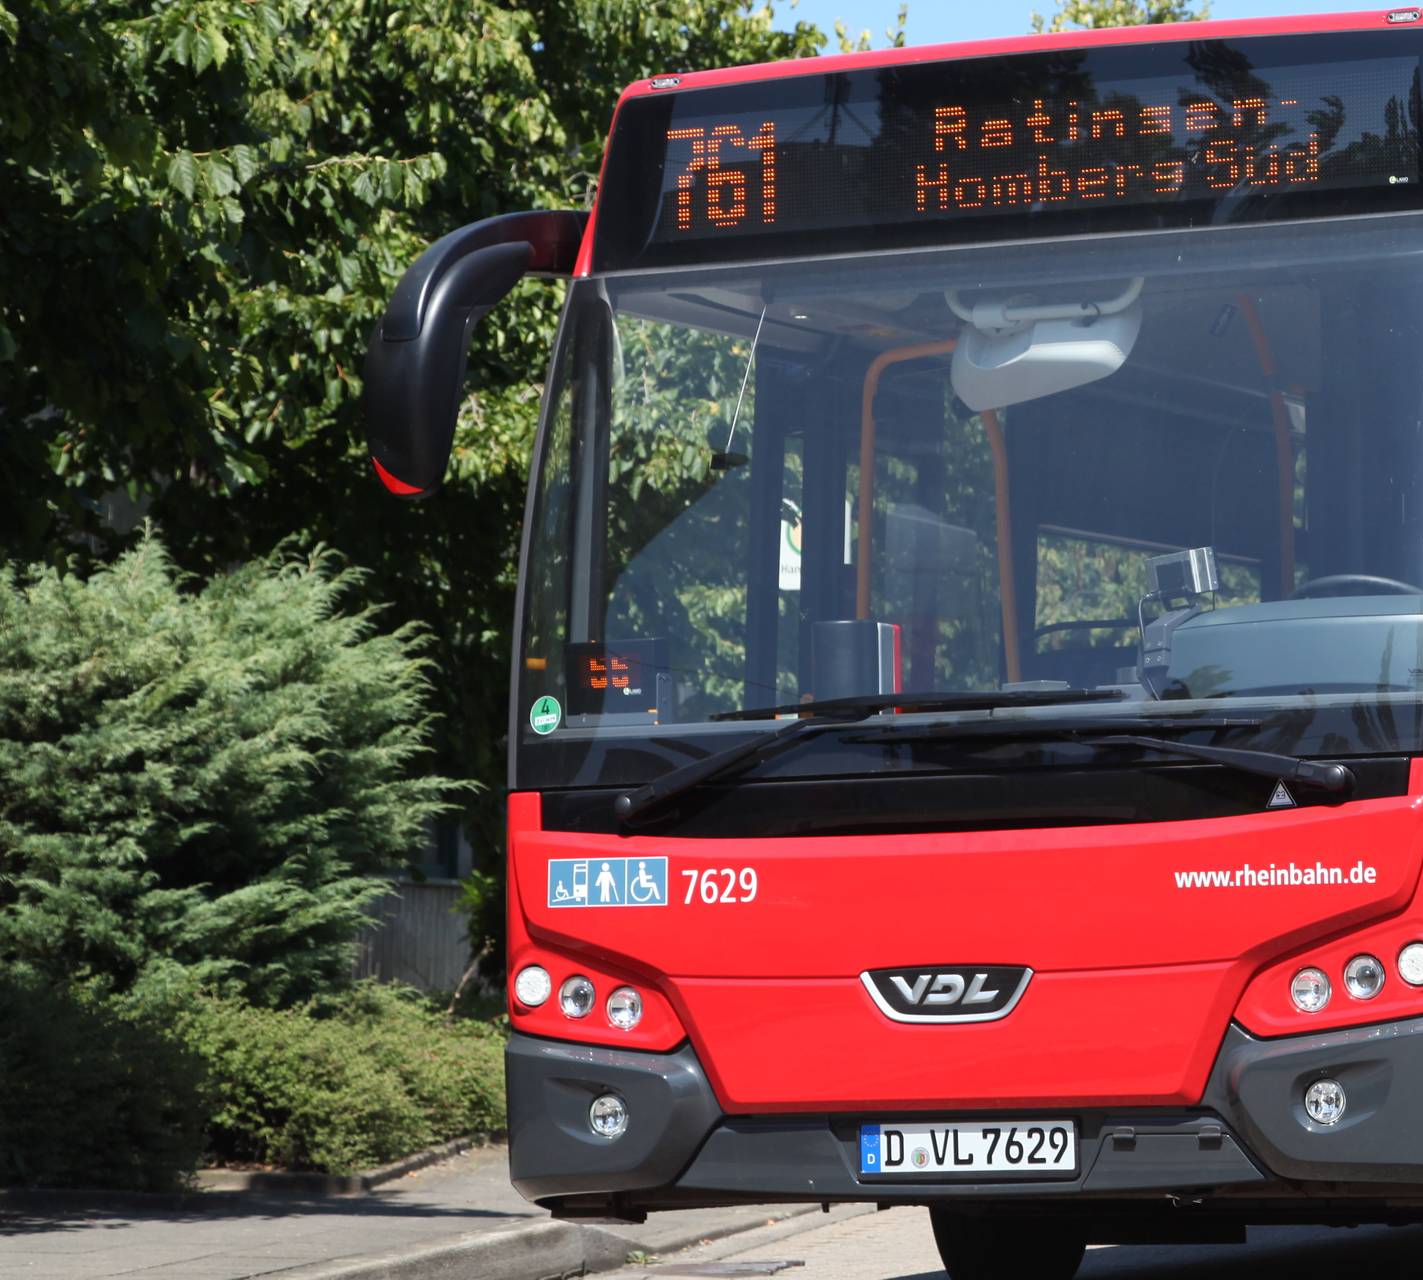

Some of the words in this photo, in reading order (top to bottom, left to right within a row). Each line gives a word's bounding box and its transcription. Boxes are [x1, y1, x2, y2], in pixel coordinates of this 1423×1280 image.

[666, 122, 774, 229] 761
[916, 155, 1185, 211] Homberg
[1206, 133, 1319, 189] Süd
[541, 698, 550, 715] 4
[681, 867, 758, 905] 7629
[1174, 860, 1377, 888] www.rheinbahn.de
[889, 973, 1000, 1006] VDL
[866, 1153, 876, 1165] D
[884, 1130, 905, 1167] D
[929, 1128, 974, 1166] VL
[981, 1126, 1069, 1165] 7629
